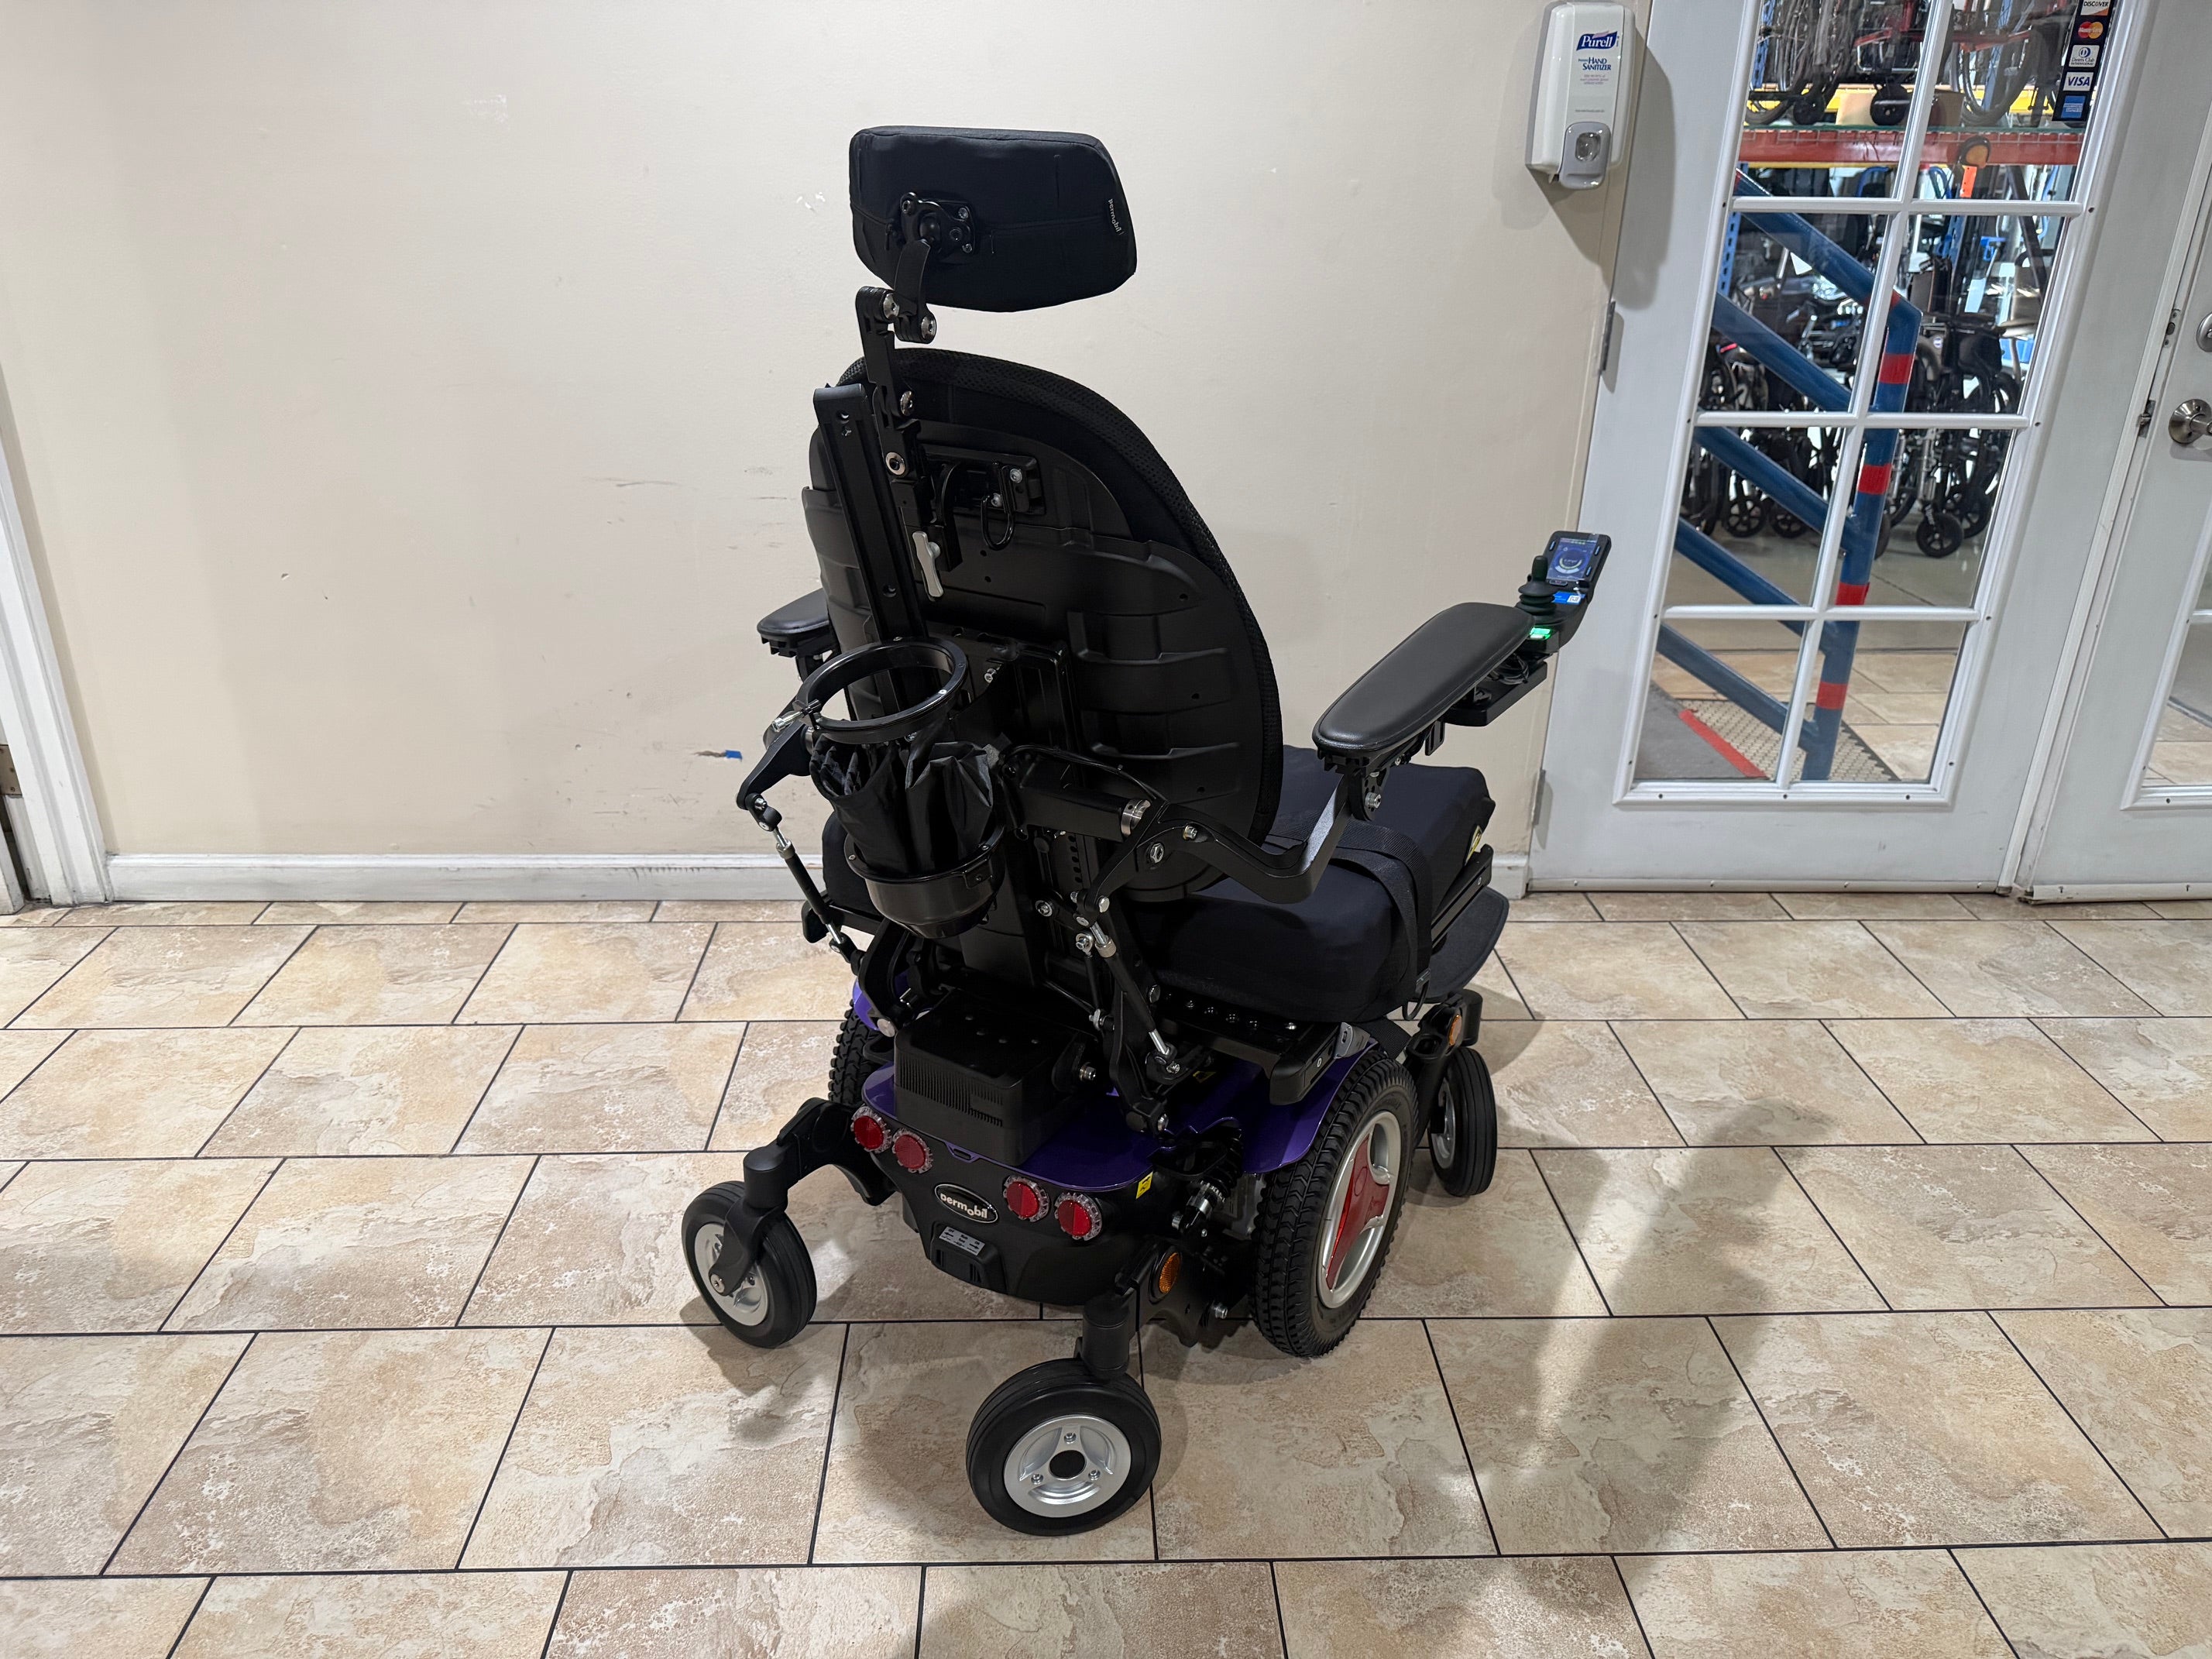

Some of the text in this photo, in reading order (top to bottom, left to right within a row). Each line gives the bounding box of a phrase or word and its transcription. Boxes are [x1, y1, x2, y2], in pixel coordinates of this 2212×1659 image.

[1581, 35, 1613, 47] Purell
[2068, 77, 2090, 86] VISA
[1108, 198, 1122, 232] permobil
